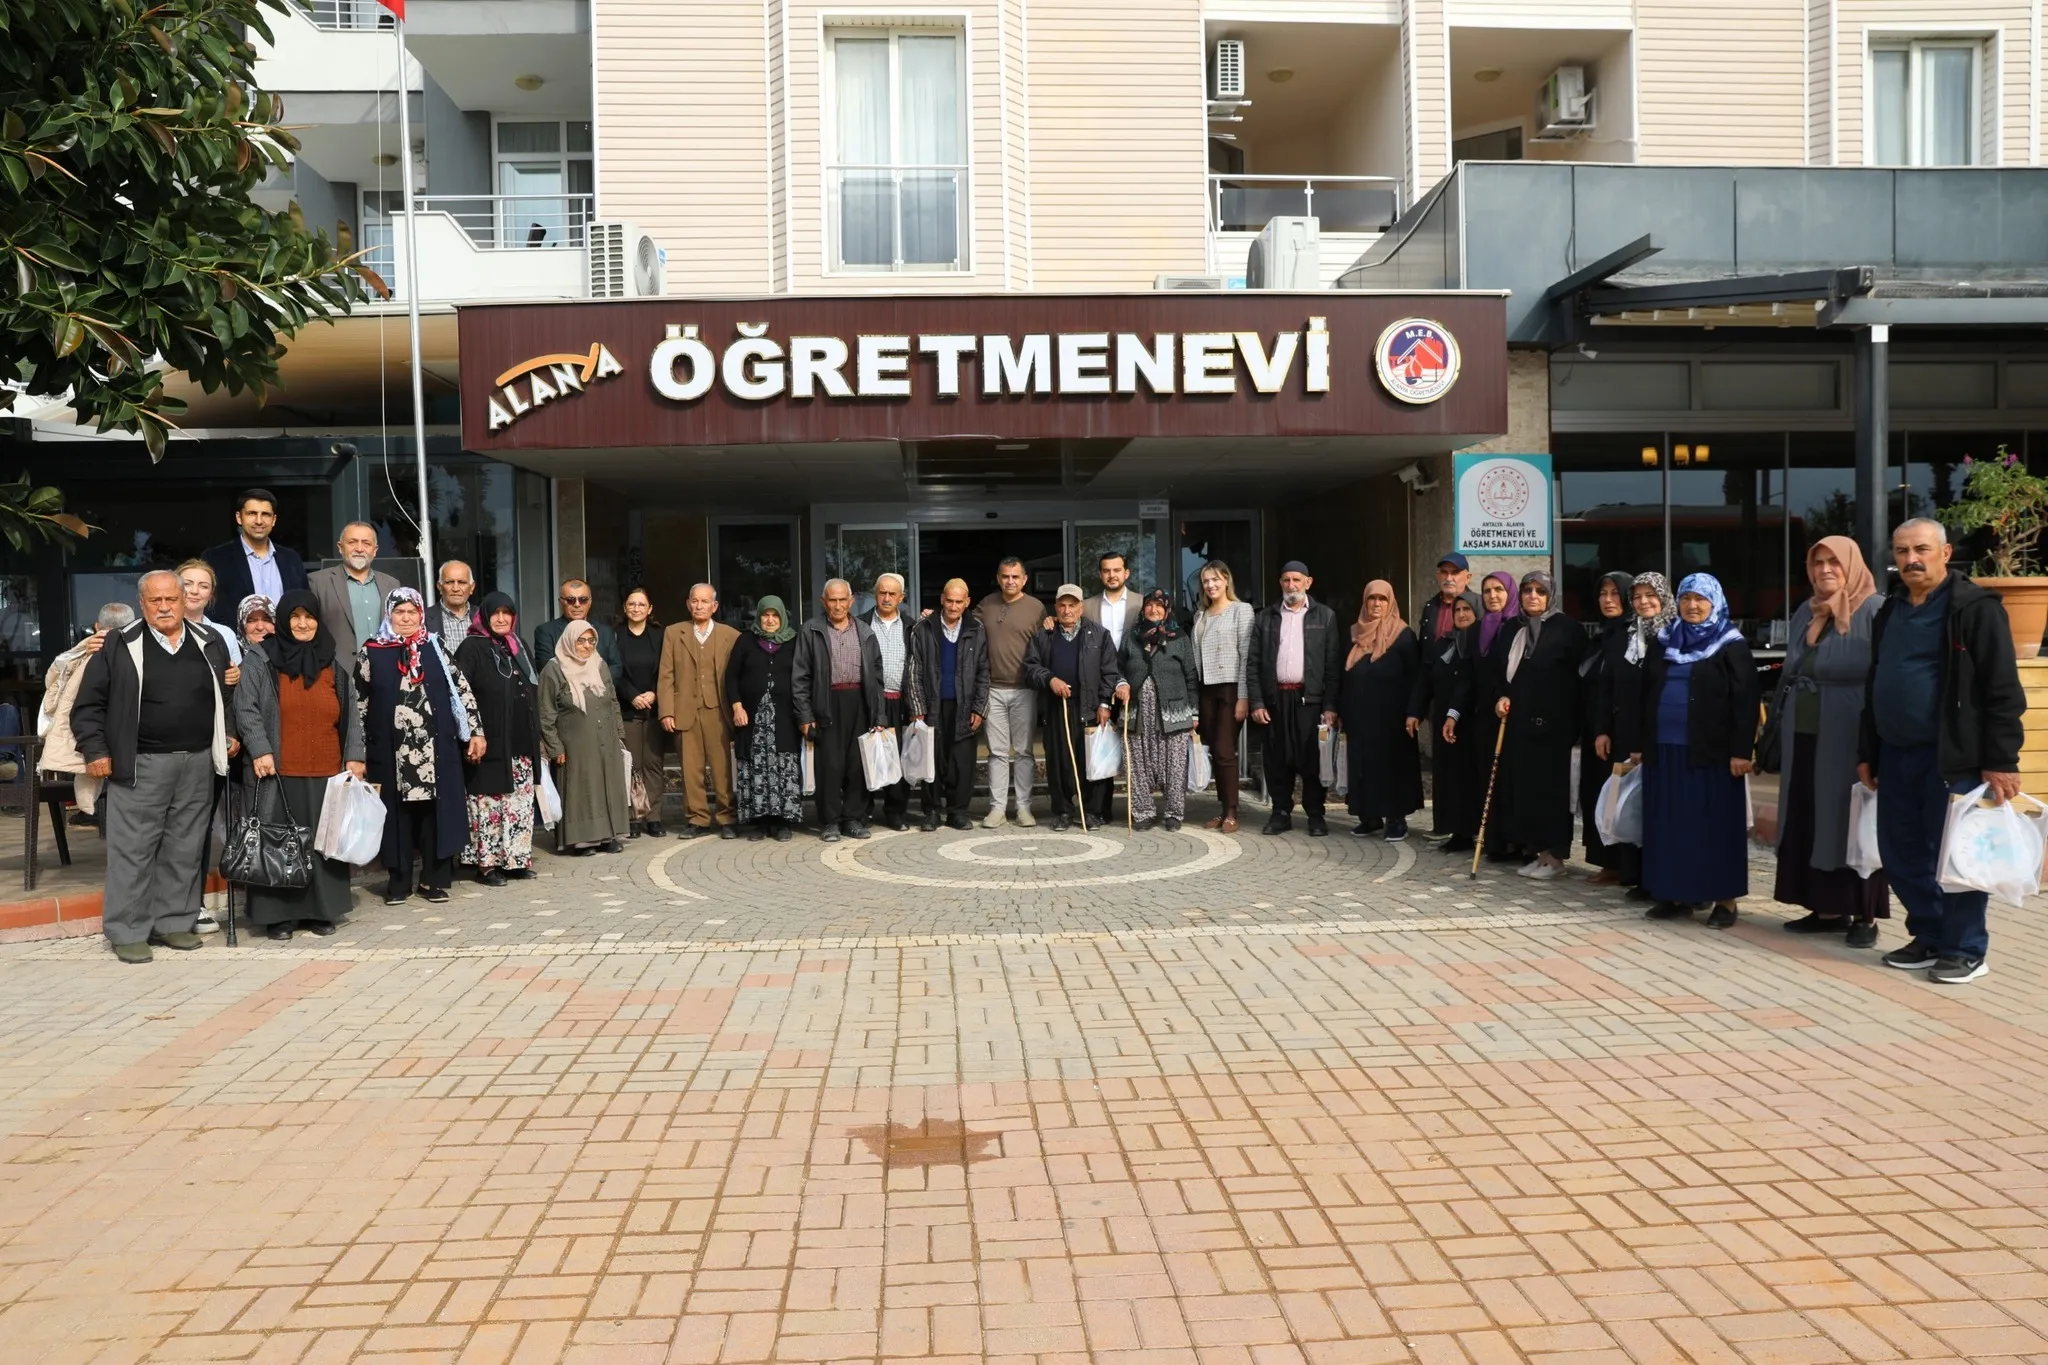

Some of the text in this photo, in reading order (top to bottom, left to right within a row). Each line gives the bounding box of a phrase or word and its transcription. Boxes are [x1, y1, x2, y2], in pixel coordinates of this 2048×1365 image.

[1405, 329, 1434, 340] M.E.B.
[488, 316, 1331, 430] ALANYA ÖĞRETMENEVİ
[1471, 528, 1536, 538] ÖĞRETMENEVİ VE
[1463, 540, 1545, 549] AKŞAM SANAT OKULU
